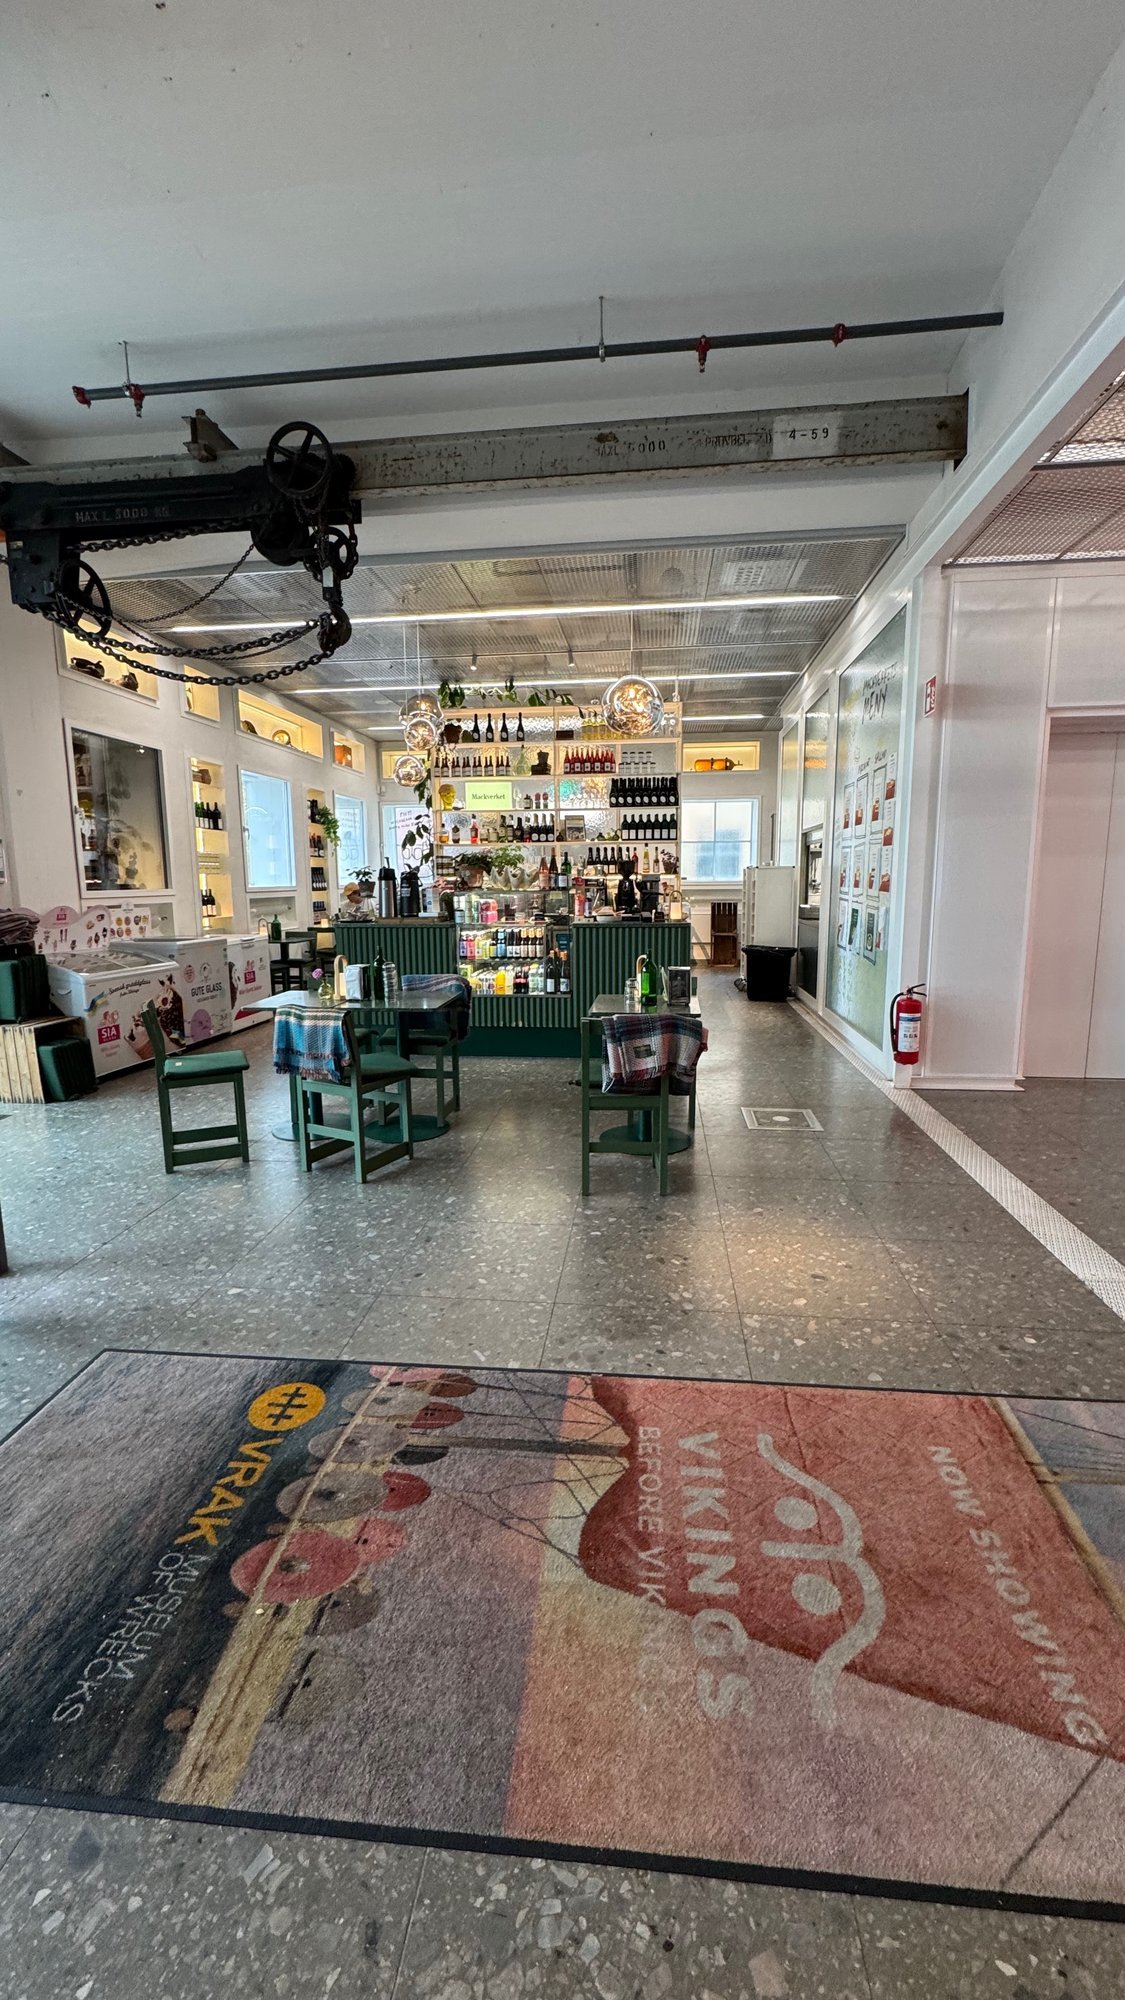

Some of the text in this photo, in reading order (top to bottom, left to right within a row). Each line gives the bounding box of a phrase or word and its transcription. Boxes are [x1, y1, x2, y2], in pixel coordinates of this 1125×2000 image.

[75, 511, 98, 523] MAX
[115, 507, 148, 519] 5000
[862, 683, 888, 725] MENY
[101, 1027, 117, 1039] SIA
[191, 982, 222, 997] GUTE GLASS
[174, 1437, 285, 1546] VRAK
[638, 1425, 664, 1533] BEFORE
[112, 1553, 215, 1681] MUSEUM
[678, 1431, 755, 1721] VIKINGS
[928, 1446, 1109, 1745] NOW SHOWING
[52, 1552, 184, 1723] OF WRECKS
